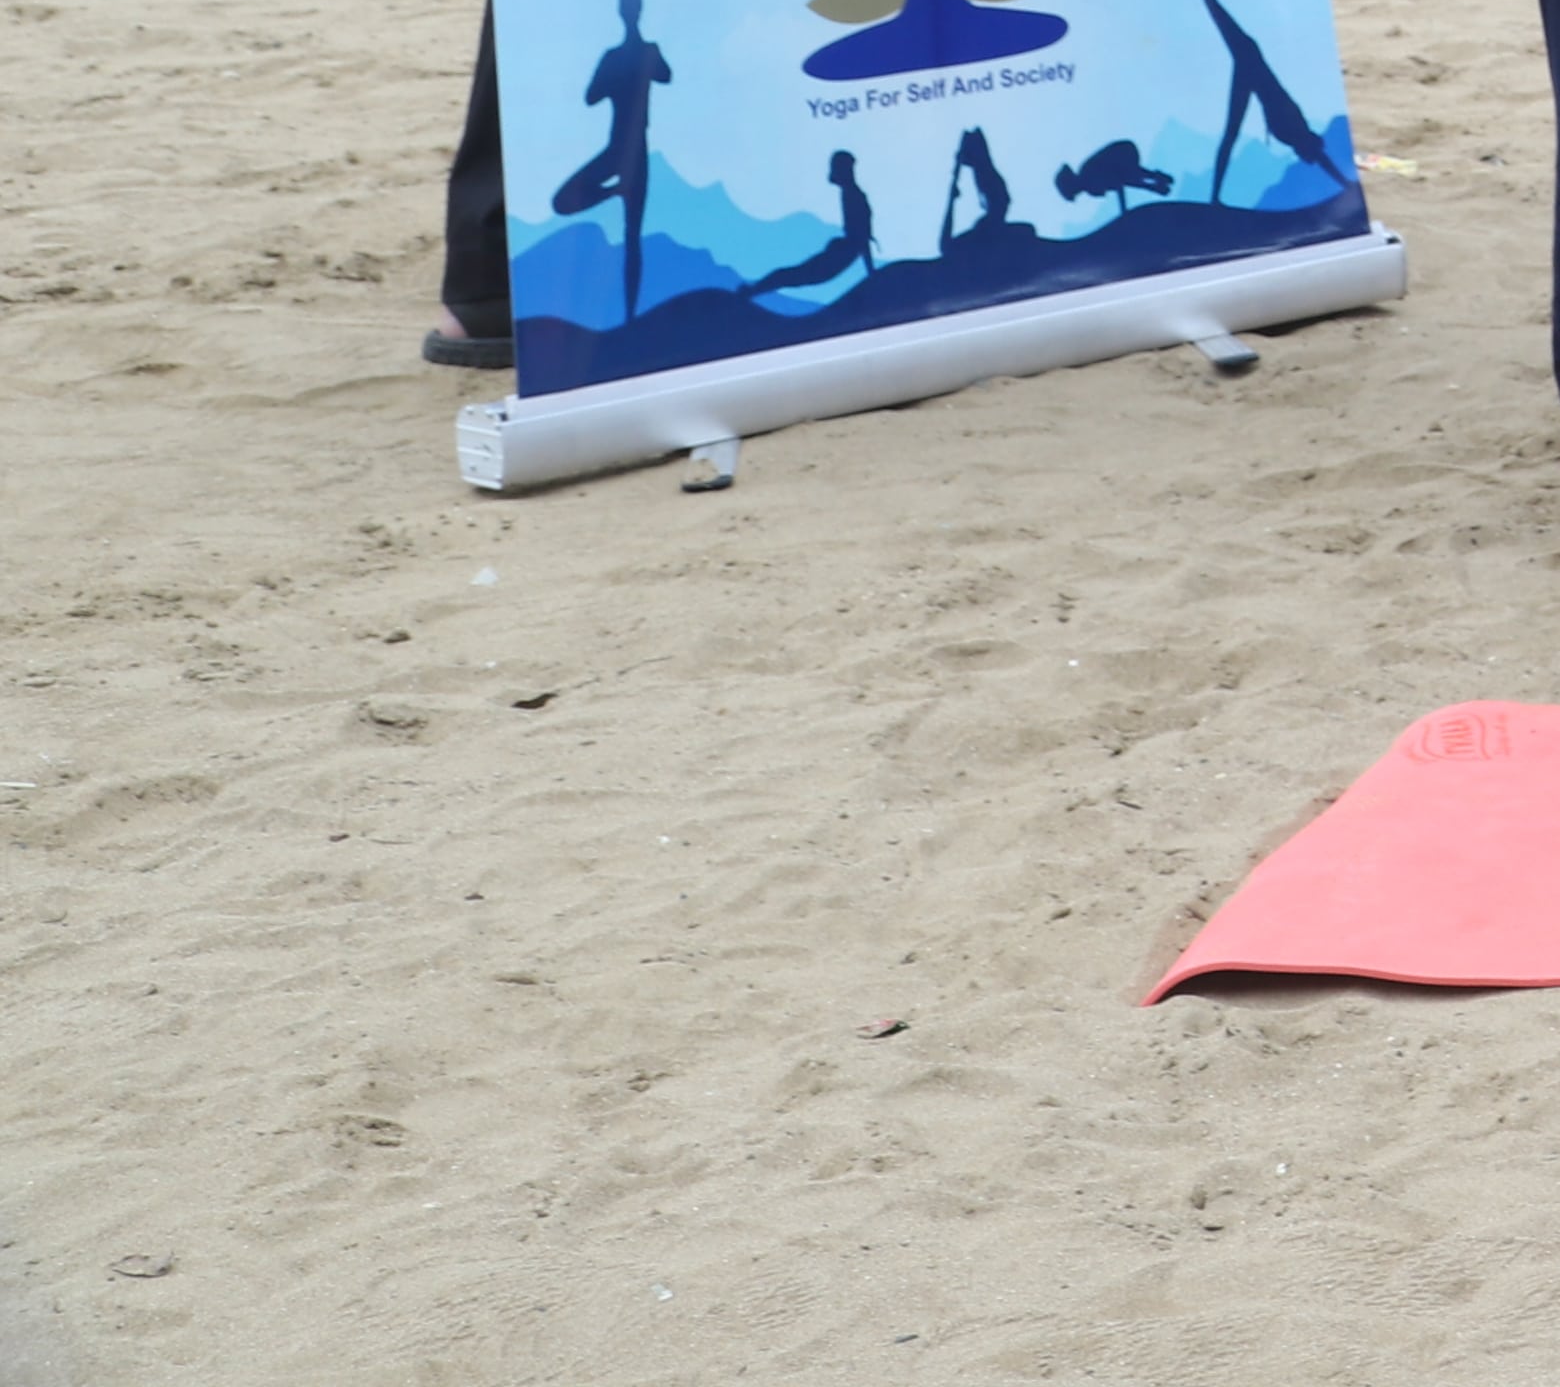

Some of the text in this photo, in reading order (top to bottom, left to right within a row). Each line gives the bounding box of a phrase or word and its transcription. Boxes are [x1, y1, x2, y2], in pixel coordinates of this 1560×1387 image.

[806, 63, 1076, 120] Yoga For Self And Society
